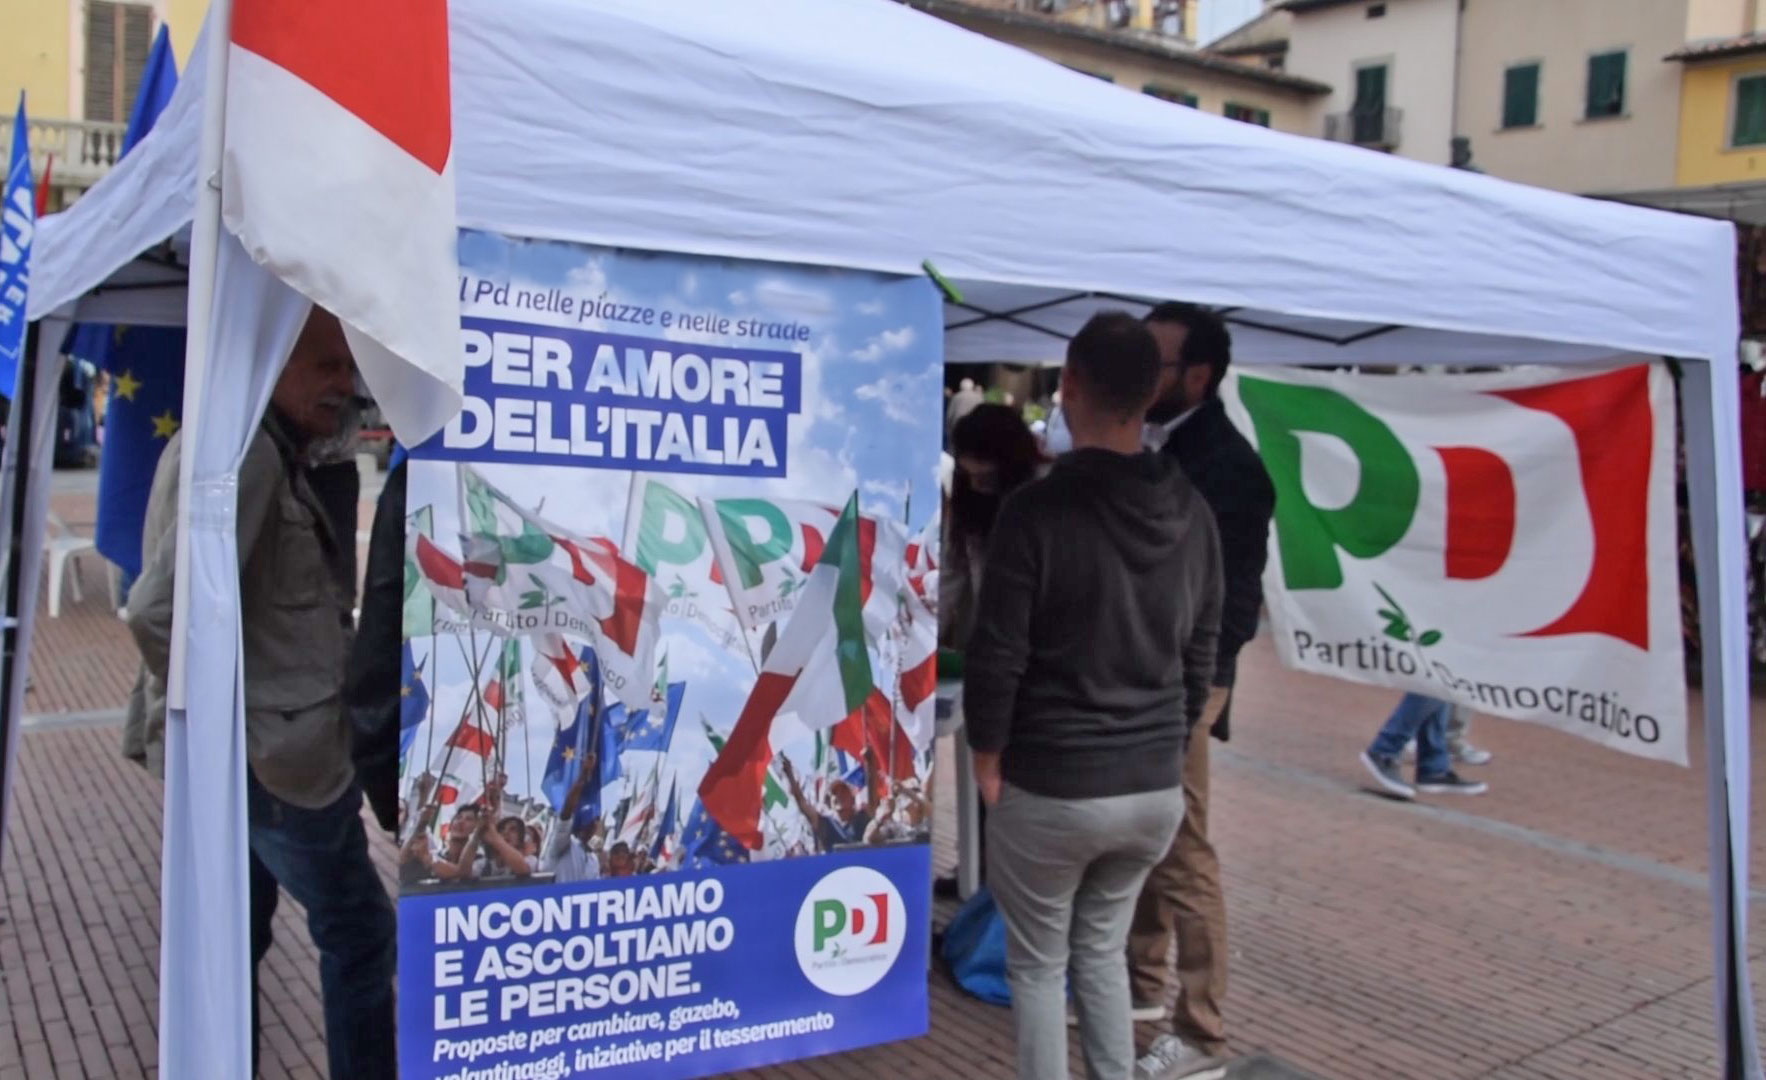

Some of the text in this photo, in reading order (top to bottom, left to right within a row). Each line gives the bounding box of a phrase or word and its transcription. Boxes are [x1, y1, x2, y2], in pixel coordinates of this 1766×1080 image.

[474, 279, 510, 306] Pd
[516, 288, 574, 315] nelle
[578, 295, 655, 325] piazze
[660, 309, 673, 328] e
[678, 312, 730, 335] nelle
[736, 317, 811, 342] strade
[460, 328, 785, 409] PER AMORE
[443, 395, 779, 467] DELL'ITALIA
[1294, 629, 1417, 676] Partito
[434, 878, 724, 944] INCONTRIAMO
[434, 916, 735, 988] E ASCOLTIAMO
[433, 997, 740, 1062] Proposte per cambiare, gazebo,
[434, 962, 701, 1031] LE PERSONE.
[574, 1039, 663, 1072] iniziative
[664, 1036, 698, 1062] per
[699, 1028, 712, 1051] il
[713, 1011, 835, 1049] tesseramento
